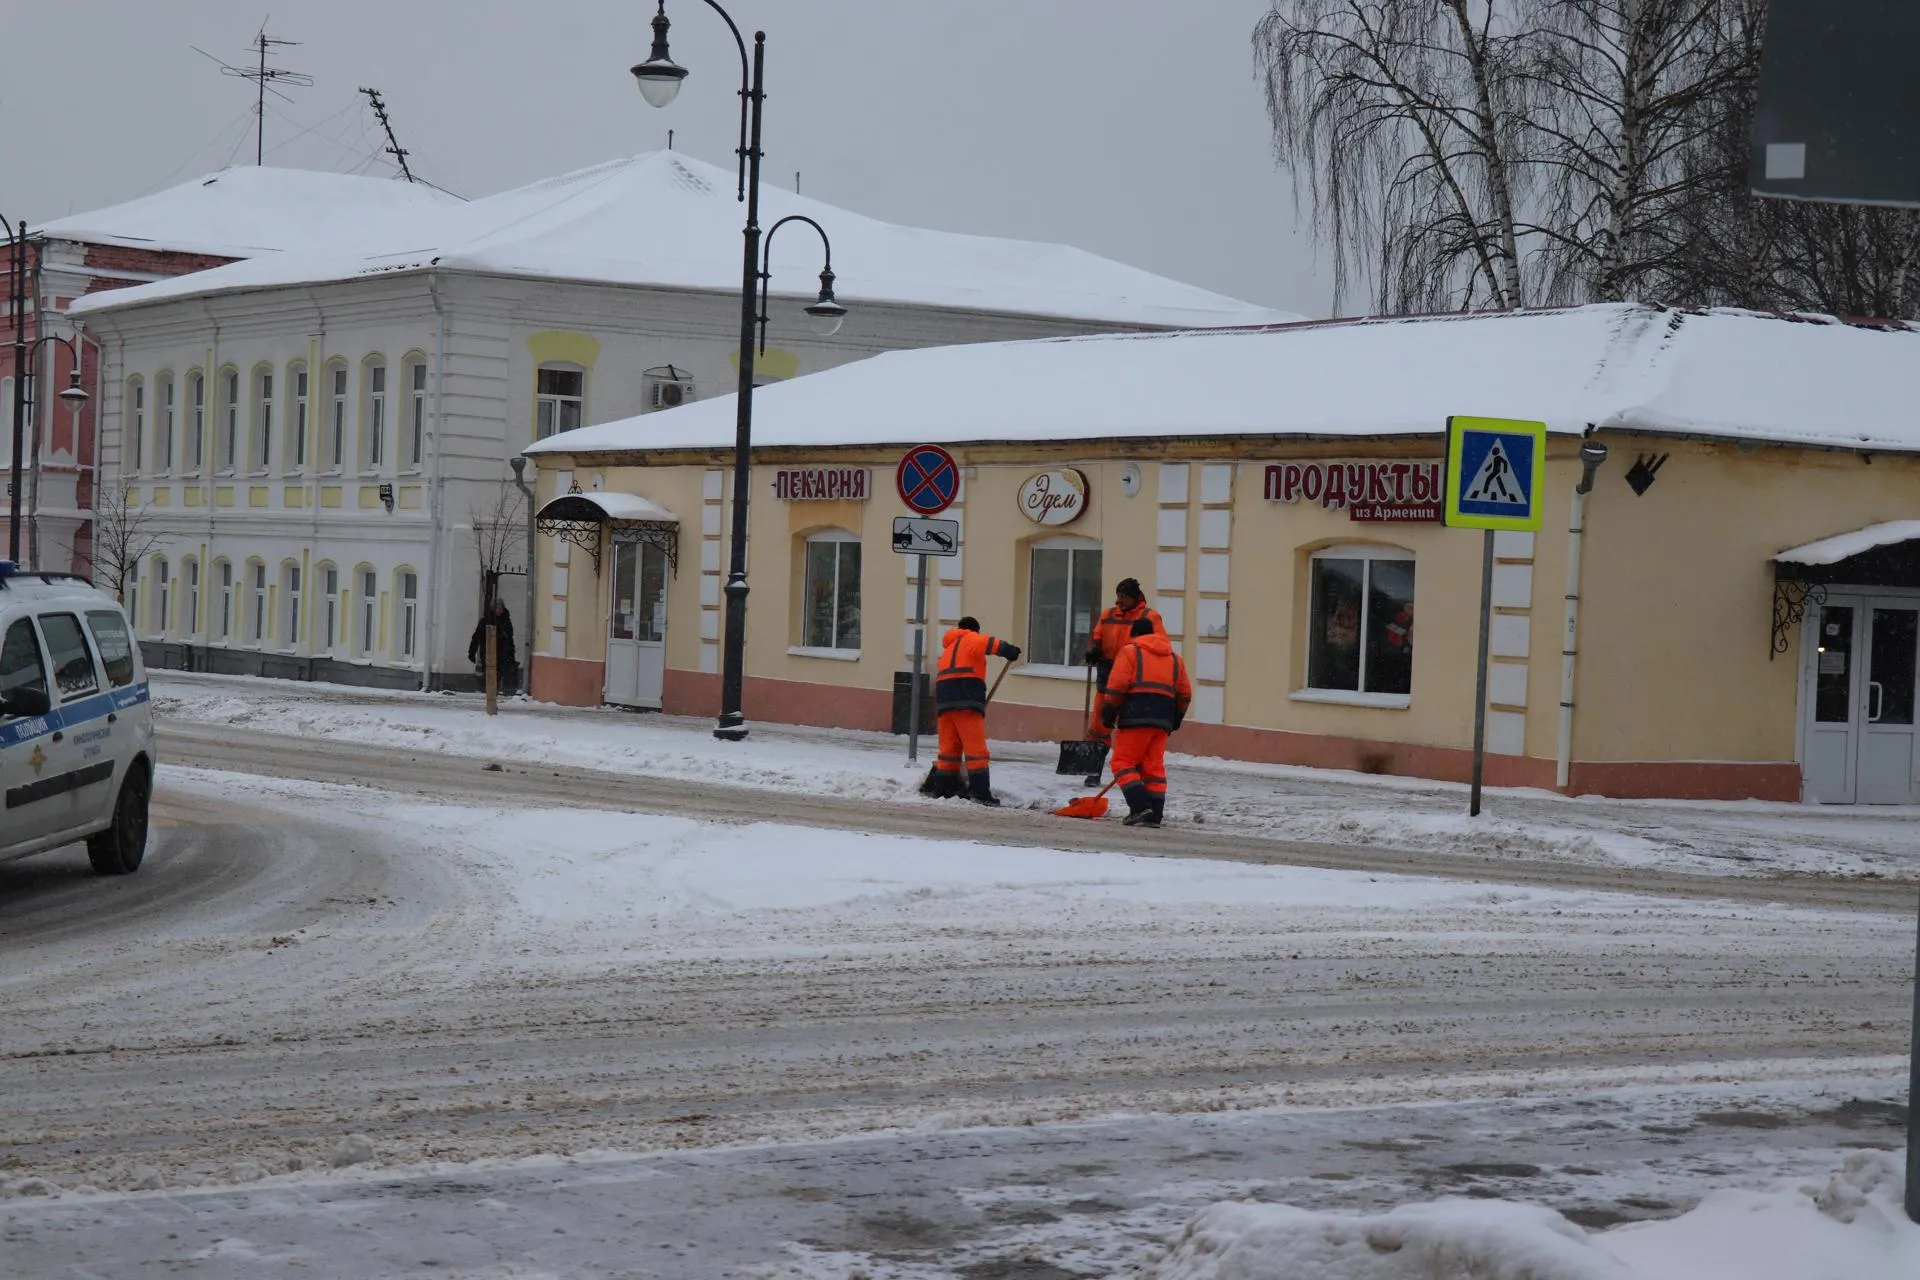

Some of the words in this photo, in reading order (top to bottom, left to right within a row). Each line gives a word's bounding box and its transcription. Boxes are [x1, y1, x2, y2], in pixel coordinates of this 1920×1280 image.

[776, 469, 865, 499] ПЕКАРНЯ
[1028, 474, 1077, 523] Эдем
[1264, 463, 1440, 508] ПРОДУКТЫ
[1355, 509, 1371, 519] из
[1374, 505, 1435, 521] Армении
[15, 717, 49, 739] ПОЛИЦИЯ
